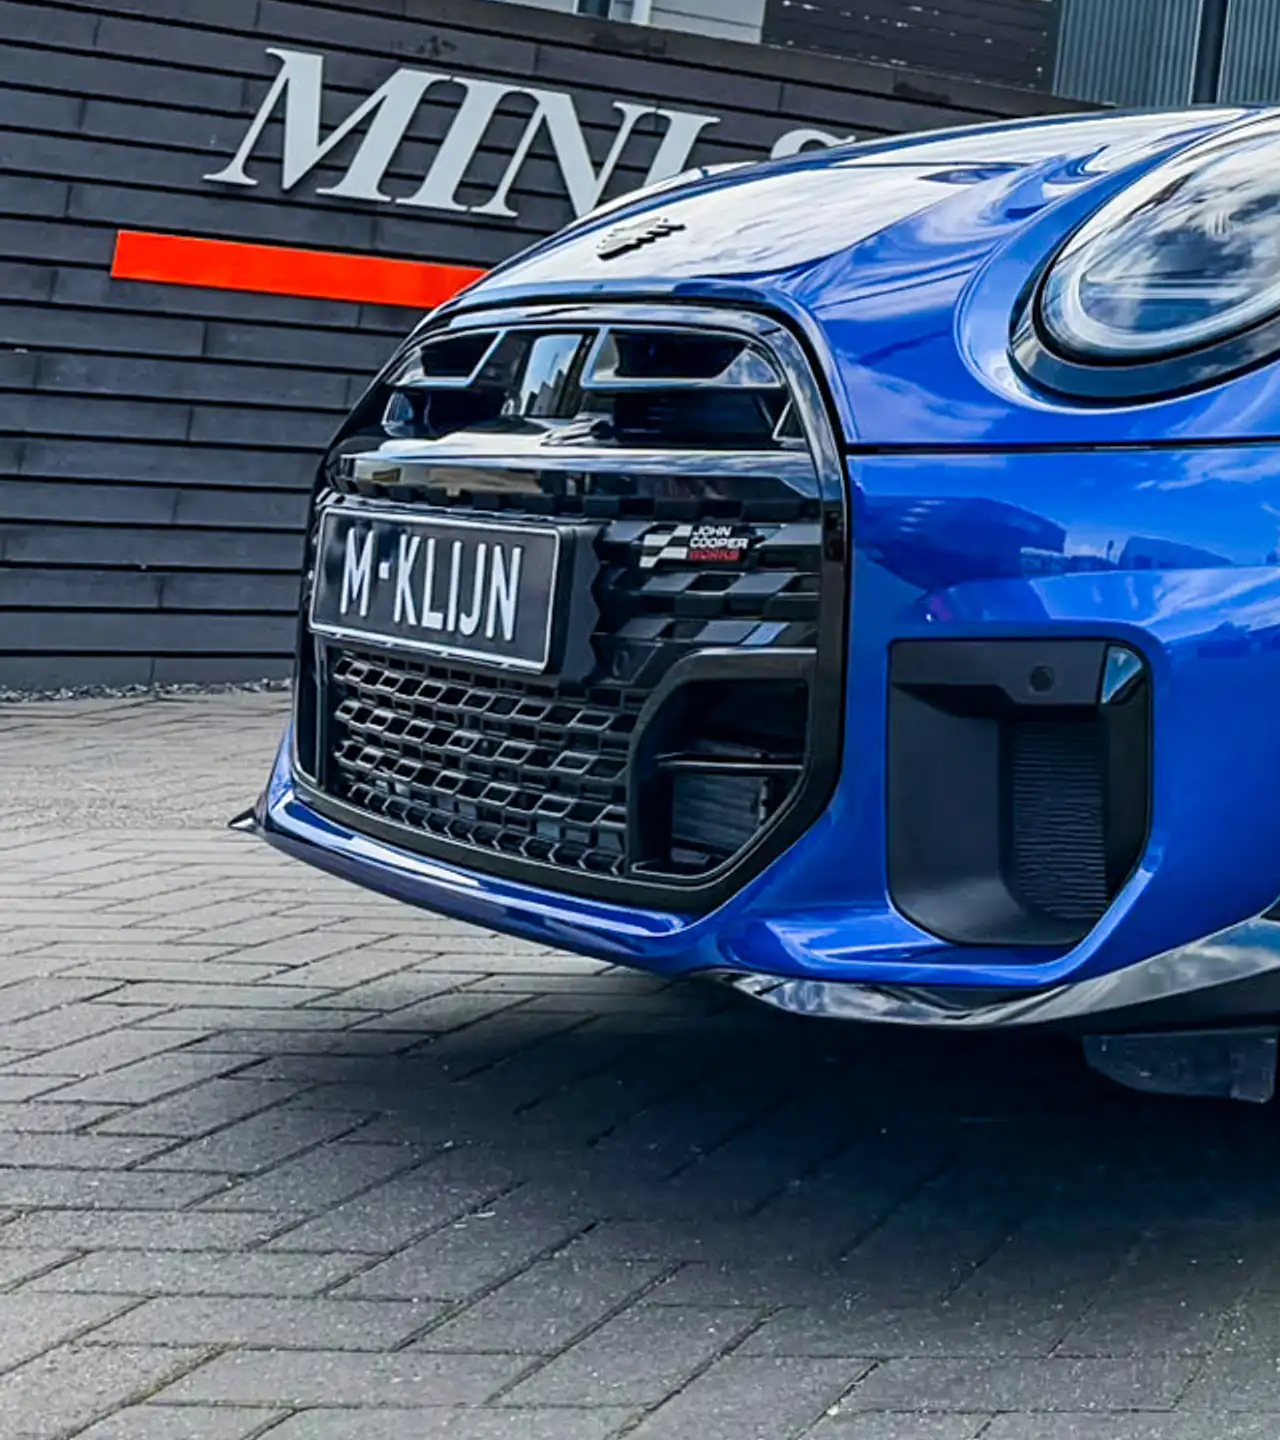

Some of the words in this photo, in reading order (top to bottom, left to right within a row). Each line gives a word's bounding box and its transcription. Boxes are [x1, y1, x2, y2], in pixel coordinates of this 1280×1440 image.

[203, 47, 721, 220] MINI
[690, 537, 749, 549] COOPER
[692, 524, 732, 537] JOHN
[339, 526, 522, 641] M-KLIJN
